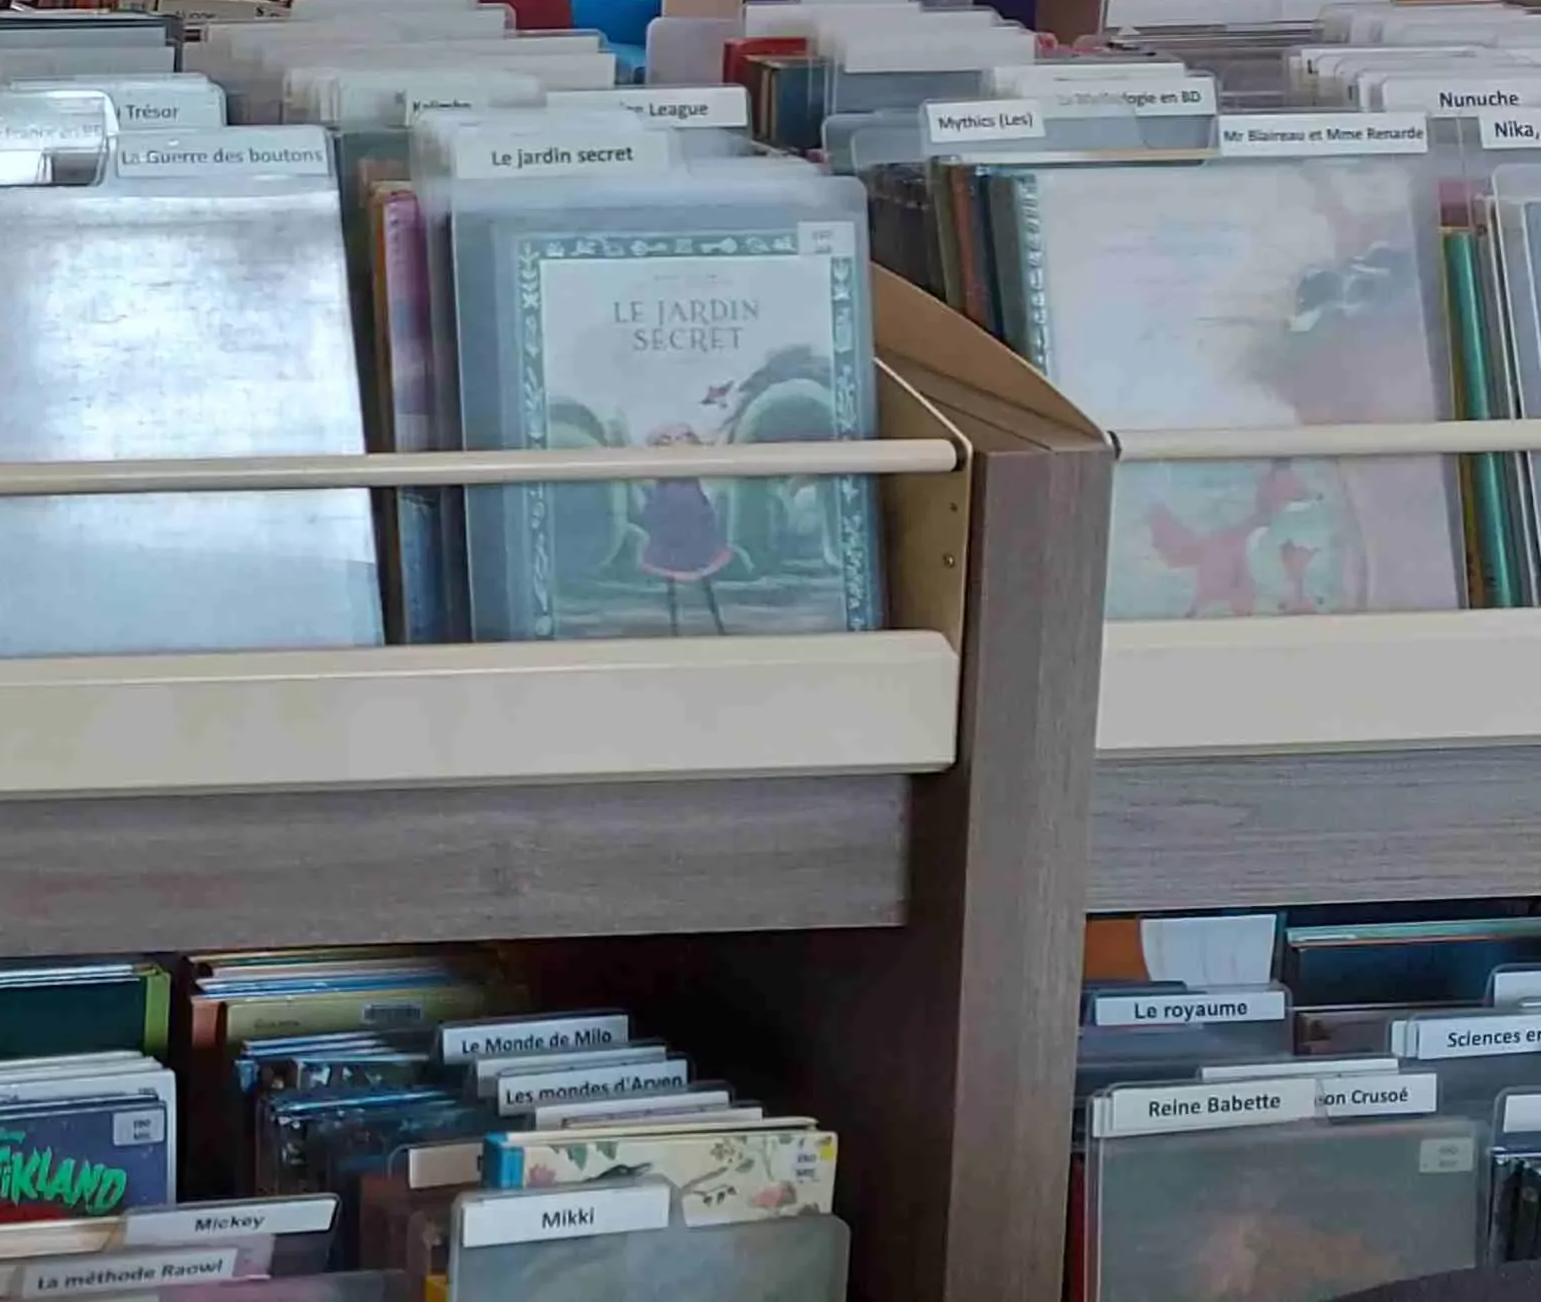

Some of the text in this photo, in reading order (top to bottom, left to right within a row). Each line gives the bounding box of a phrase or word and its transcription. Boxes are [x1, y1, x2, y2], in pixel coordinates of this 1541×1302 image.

[1181, 91, 1202, 104] BD
[1439, 91, 1521, 108] Nunuche
[126, 103, 180, 121] Trésor
[648, 102, 709, 120] League
[938, 111, 1034, 131] Mythics (Les)
[1247, 128, 1305, 142] Blaireau
[1308, 130, 1323, 141] et
[1327, 128, 1363, 140] Mme
[1367, 127, 1424, 140] Renarde
[122, 145, 324, 166] La Guerre des boutons
[491, 146, 634, 168] Le jardin secret
[613, 298, 760, 326] LE JARDIN
[632, 326, 745, 352] SECRET
[1134, 1000, 1248, 1025] Le royaume
[461, 1027, 613, 1055] Le Monde de Milo
[1447, 1029, 1521, 1048] Sciences
[506, 1087, 534, 1105] Les
[539, 1082, 610, 1101] mondes
[1351, 1087, 1410, 1105] Crusoé
[1148, 1092, 1281, 1118] Reine Babette
[195, 1213, 266, 1233] Mickey
[541, 1204, 595, 1228] Mikki
[37, 1258, 224, 1290] La méthode Raowl
